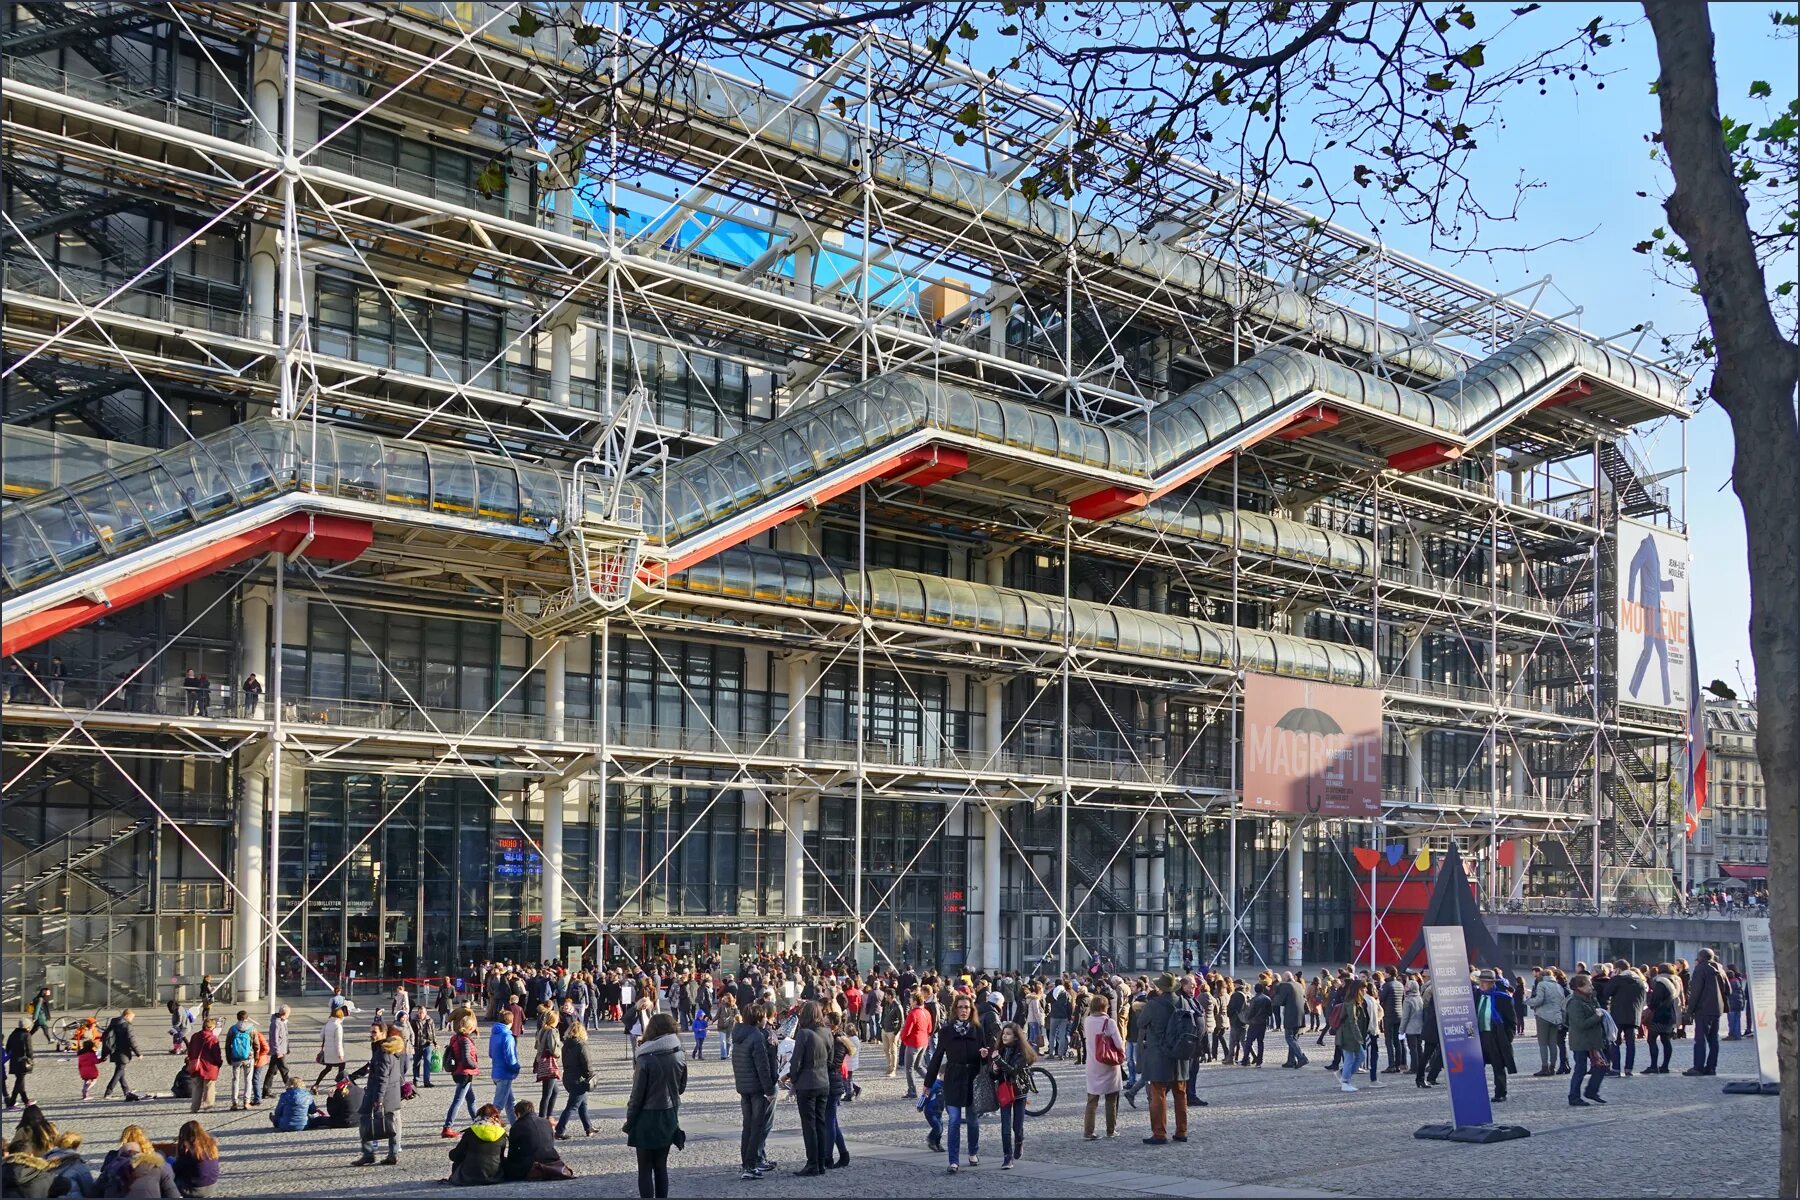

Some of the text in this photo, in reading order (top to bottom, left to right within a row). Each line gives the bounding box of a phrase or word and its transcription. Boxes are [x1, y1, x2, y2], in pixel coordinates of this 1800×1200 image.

[1621, 597, 1686, 644] MOULÈNE
[1249, 723, 1377, 783] MAGRITTE
[1326, 748, 1352, 760] MAGRITTE
[1435, 967, 1457, 977] ATELIERS
[1438, 985, 1470, 996] CONFÉRENCES
[1441, 1005, 1469, 1016] SPECTACLES
[1444, 1024, 1465, 1036] CINÉMAS
